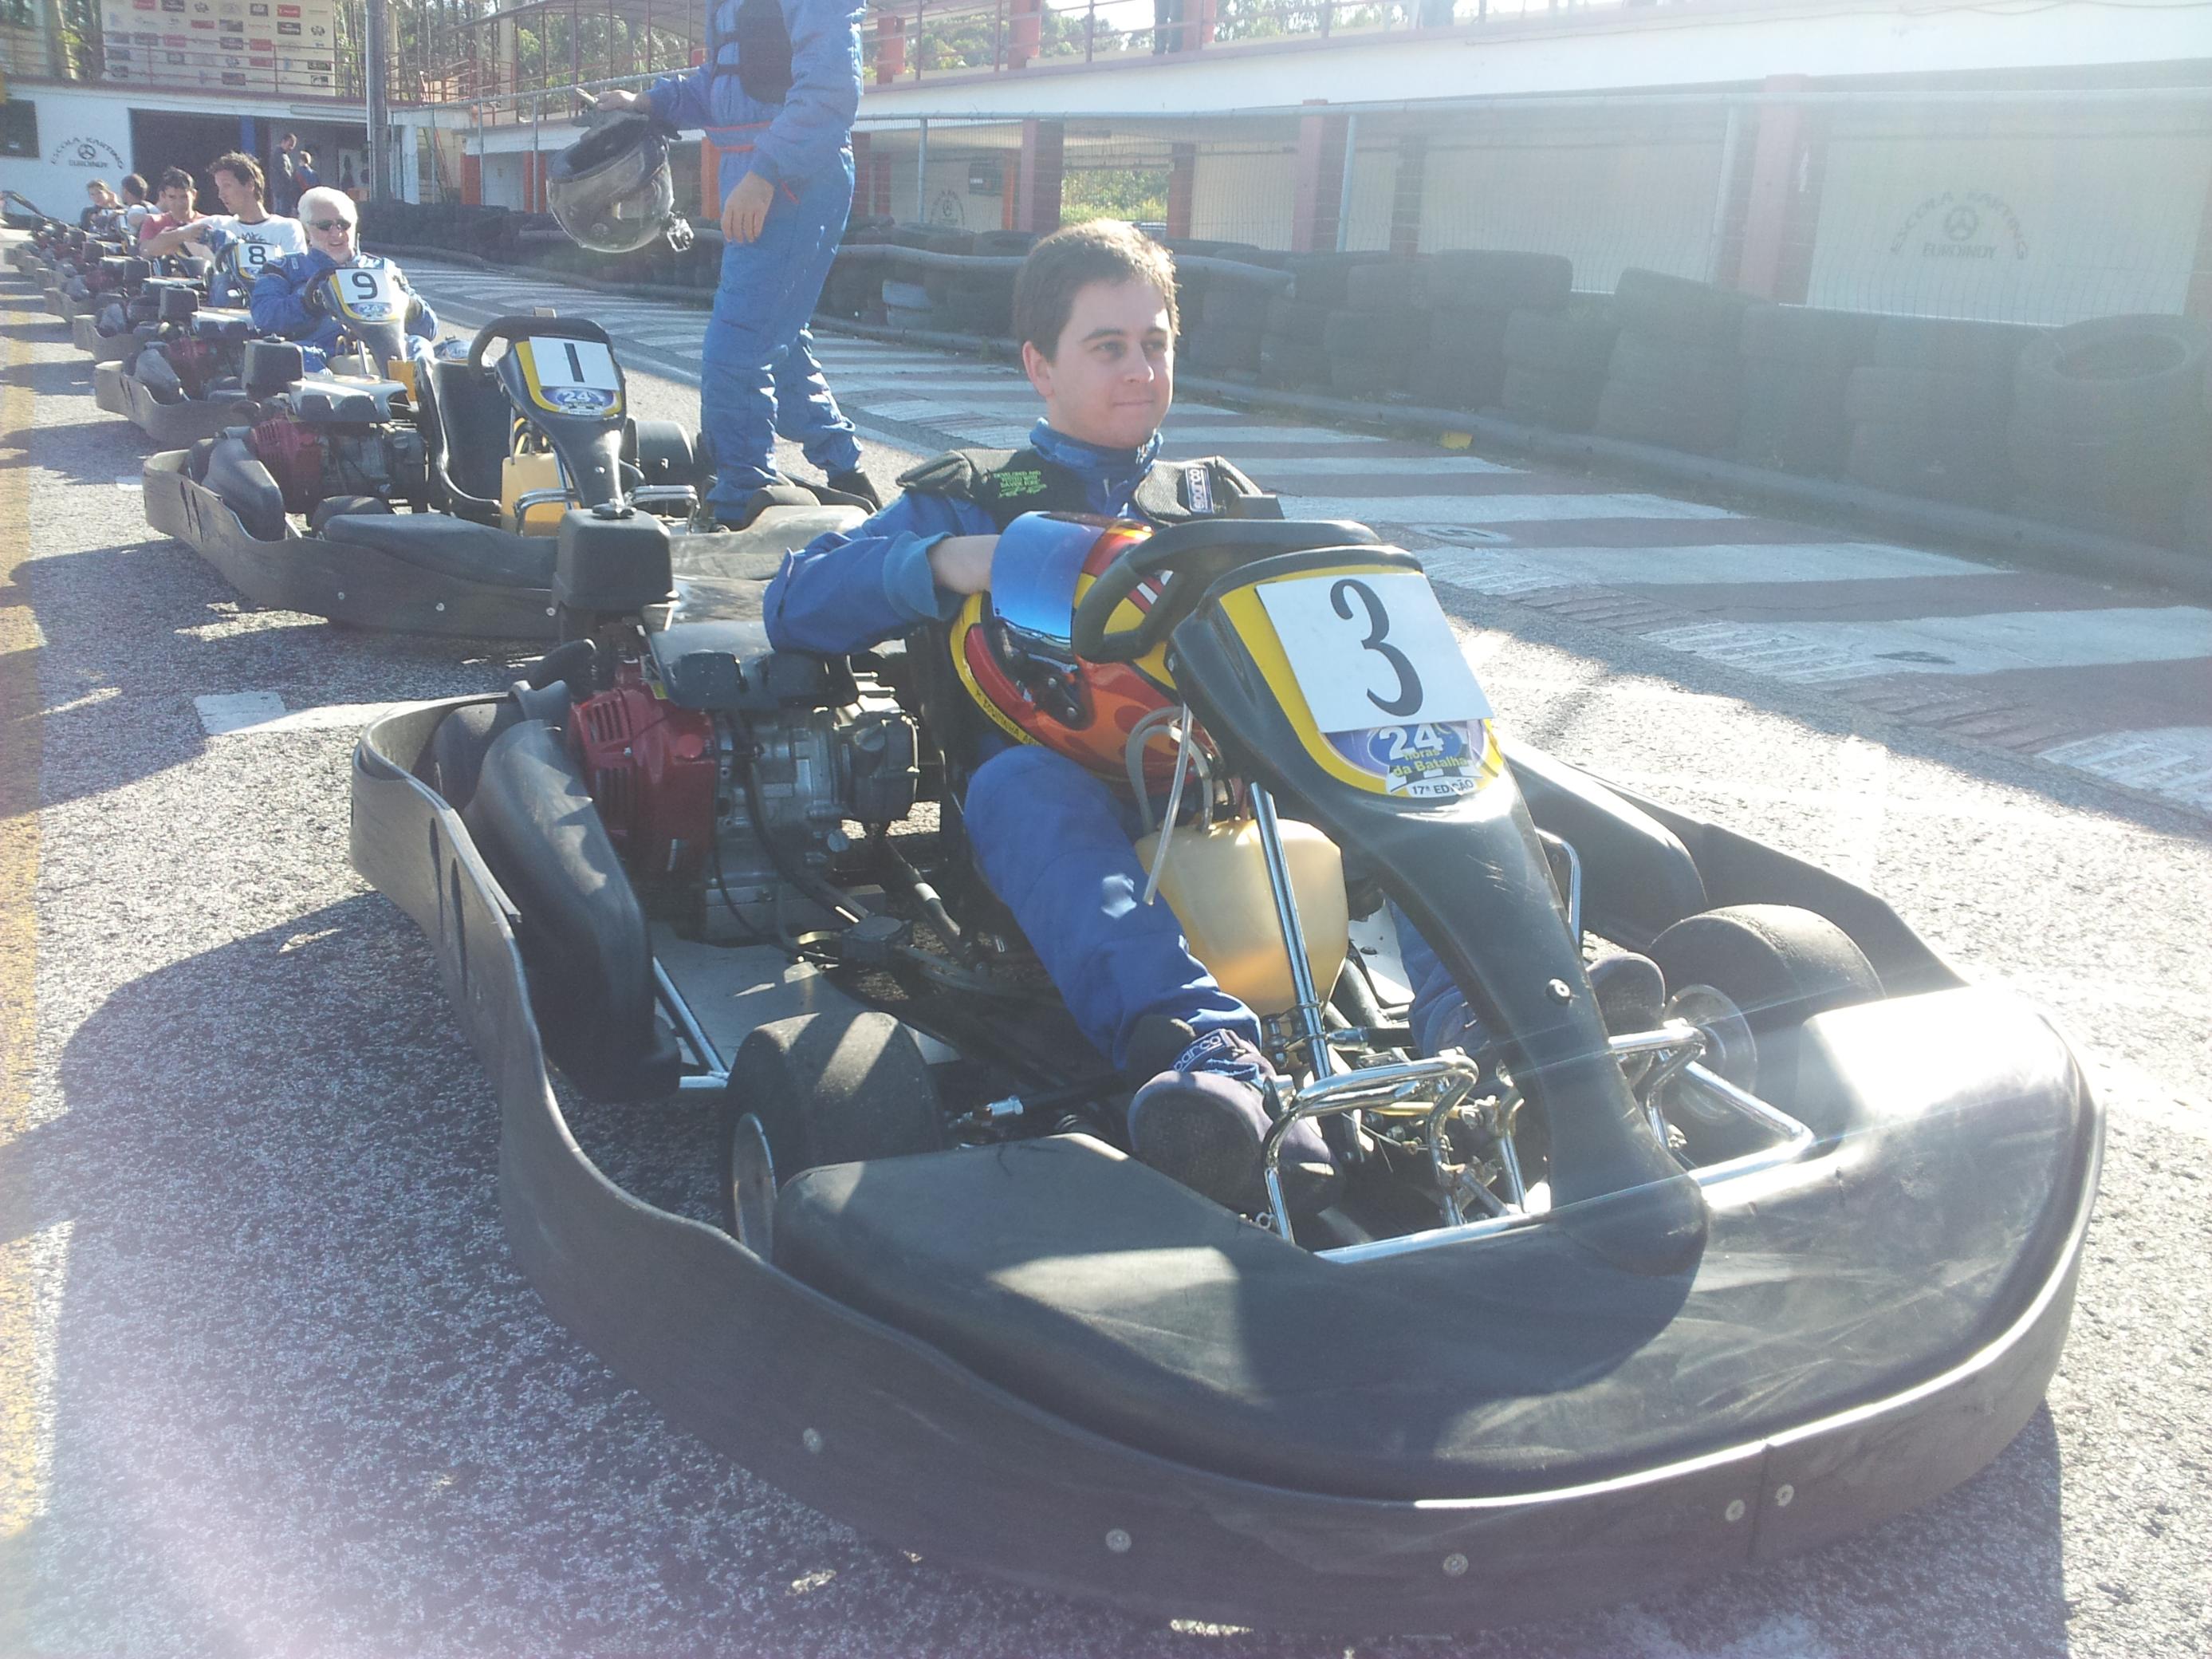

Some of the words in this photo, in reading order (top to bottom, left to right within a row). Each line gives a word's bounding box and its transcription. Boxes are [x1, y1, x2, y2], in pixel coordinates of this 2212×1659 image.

[1890, 191, 1954, 255] ESCOLA
[1966, 191, 2029, 260] KARTING
[248, 246, 266, 265] 8
[1923, 242, 1996, 259] EUROINDY
[352, 271, 378, 300] 9
[563, 342, 585, 383] 1
[562, 391, 591, 402] 24
[1189, 468, 1206, 509] sparco
[1330, 578, 1423, 717] 3
[1379, 723, 1444, 761] 24
[1393, 765, 1412, 778] da
[1414, 755, 1469, 773] Batalha
[1174, 1035, 1222, 1072] parco
